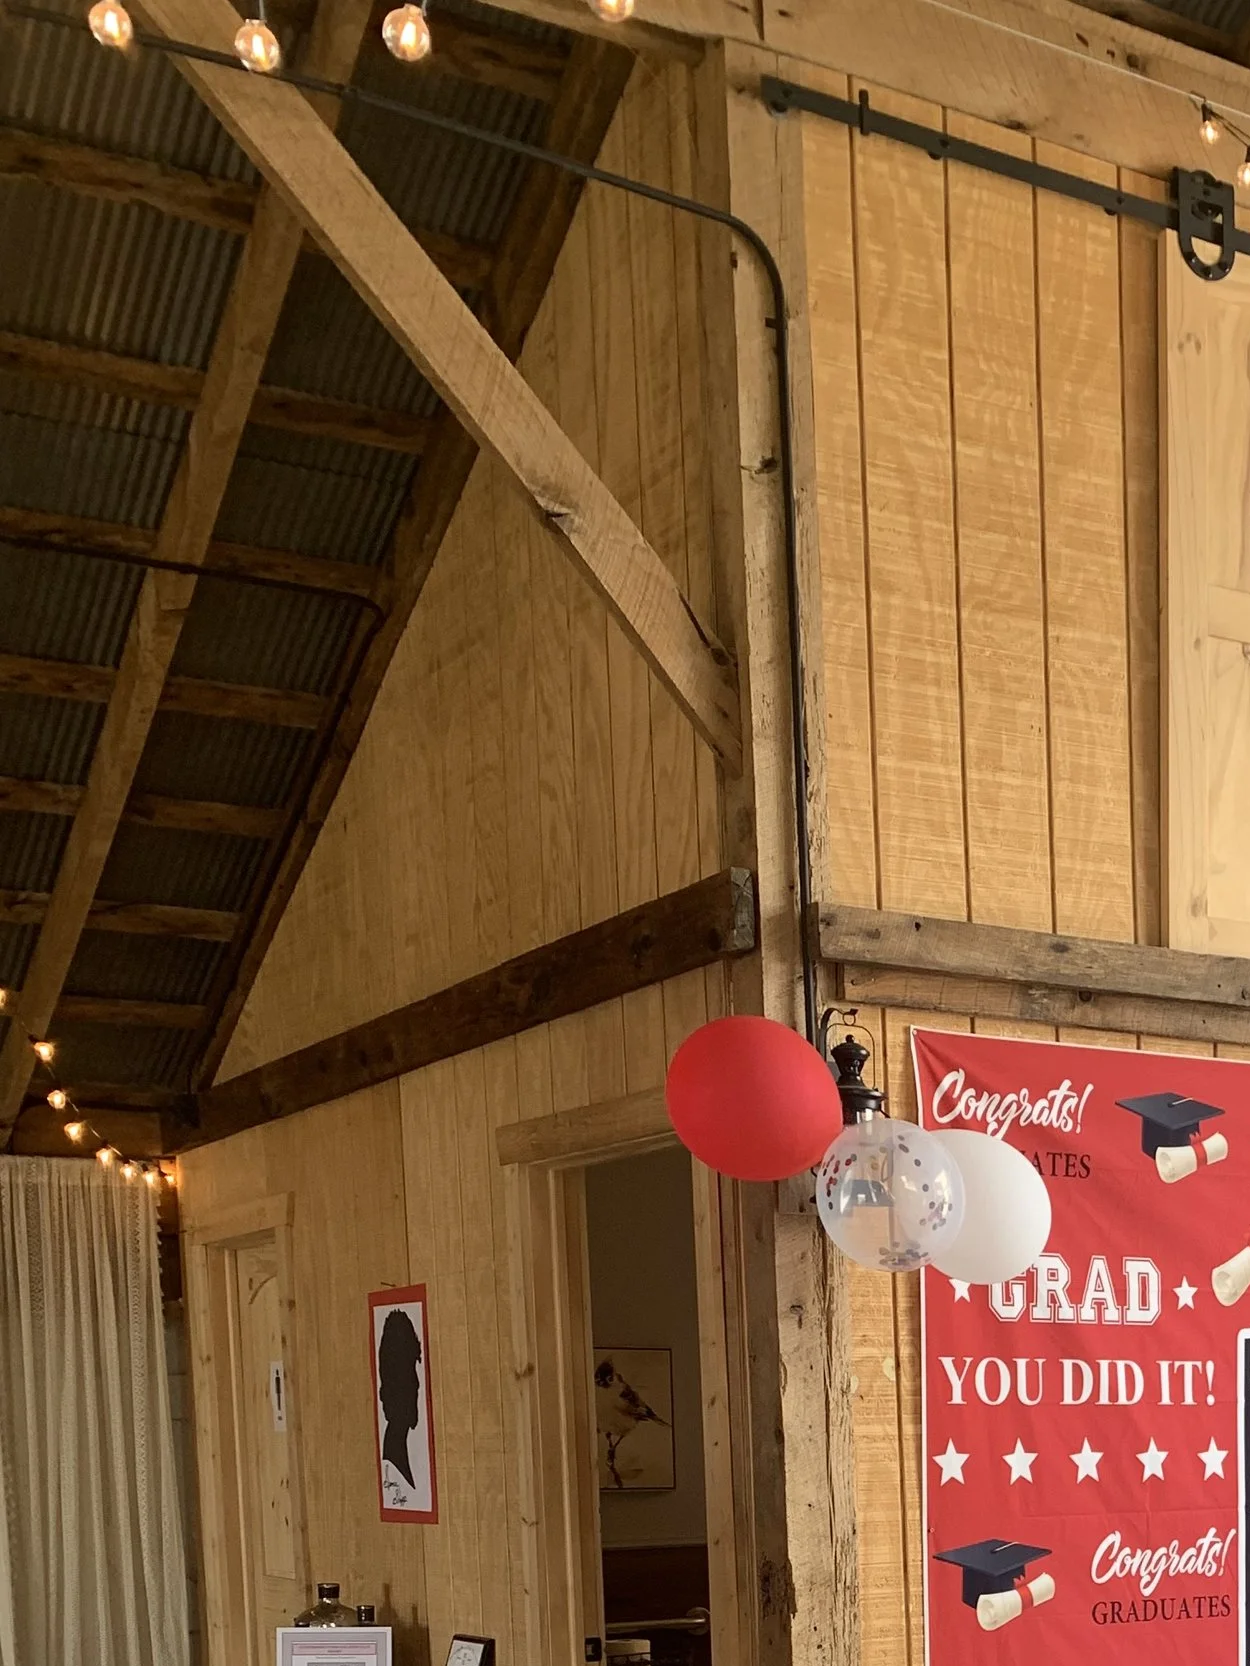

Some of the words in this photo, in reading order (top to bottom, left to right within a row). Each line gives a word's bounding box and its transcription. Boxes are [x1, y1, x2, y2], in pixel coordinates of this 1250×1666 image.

[932, 1068, 1095, 1141] Congrats!
[988, 1251, 1162, 1326] GRAD
[939, 1355, 1047, 1406] YOU
[1060, 1358, 1145, 1406] DID
[1155, 1359, 1216, 1407] IT!
[1090, 1526, 1237, 1597] Congrats!
[1091, 1594, 1232, 1626] GRADUATES
